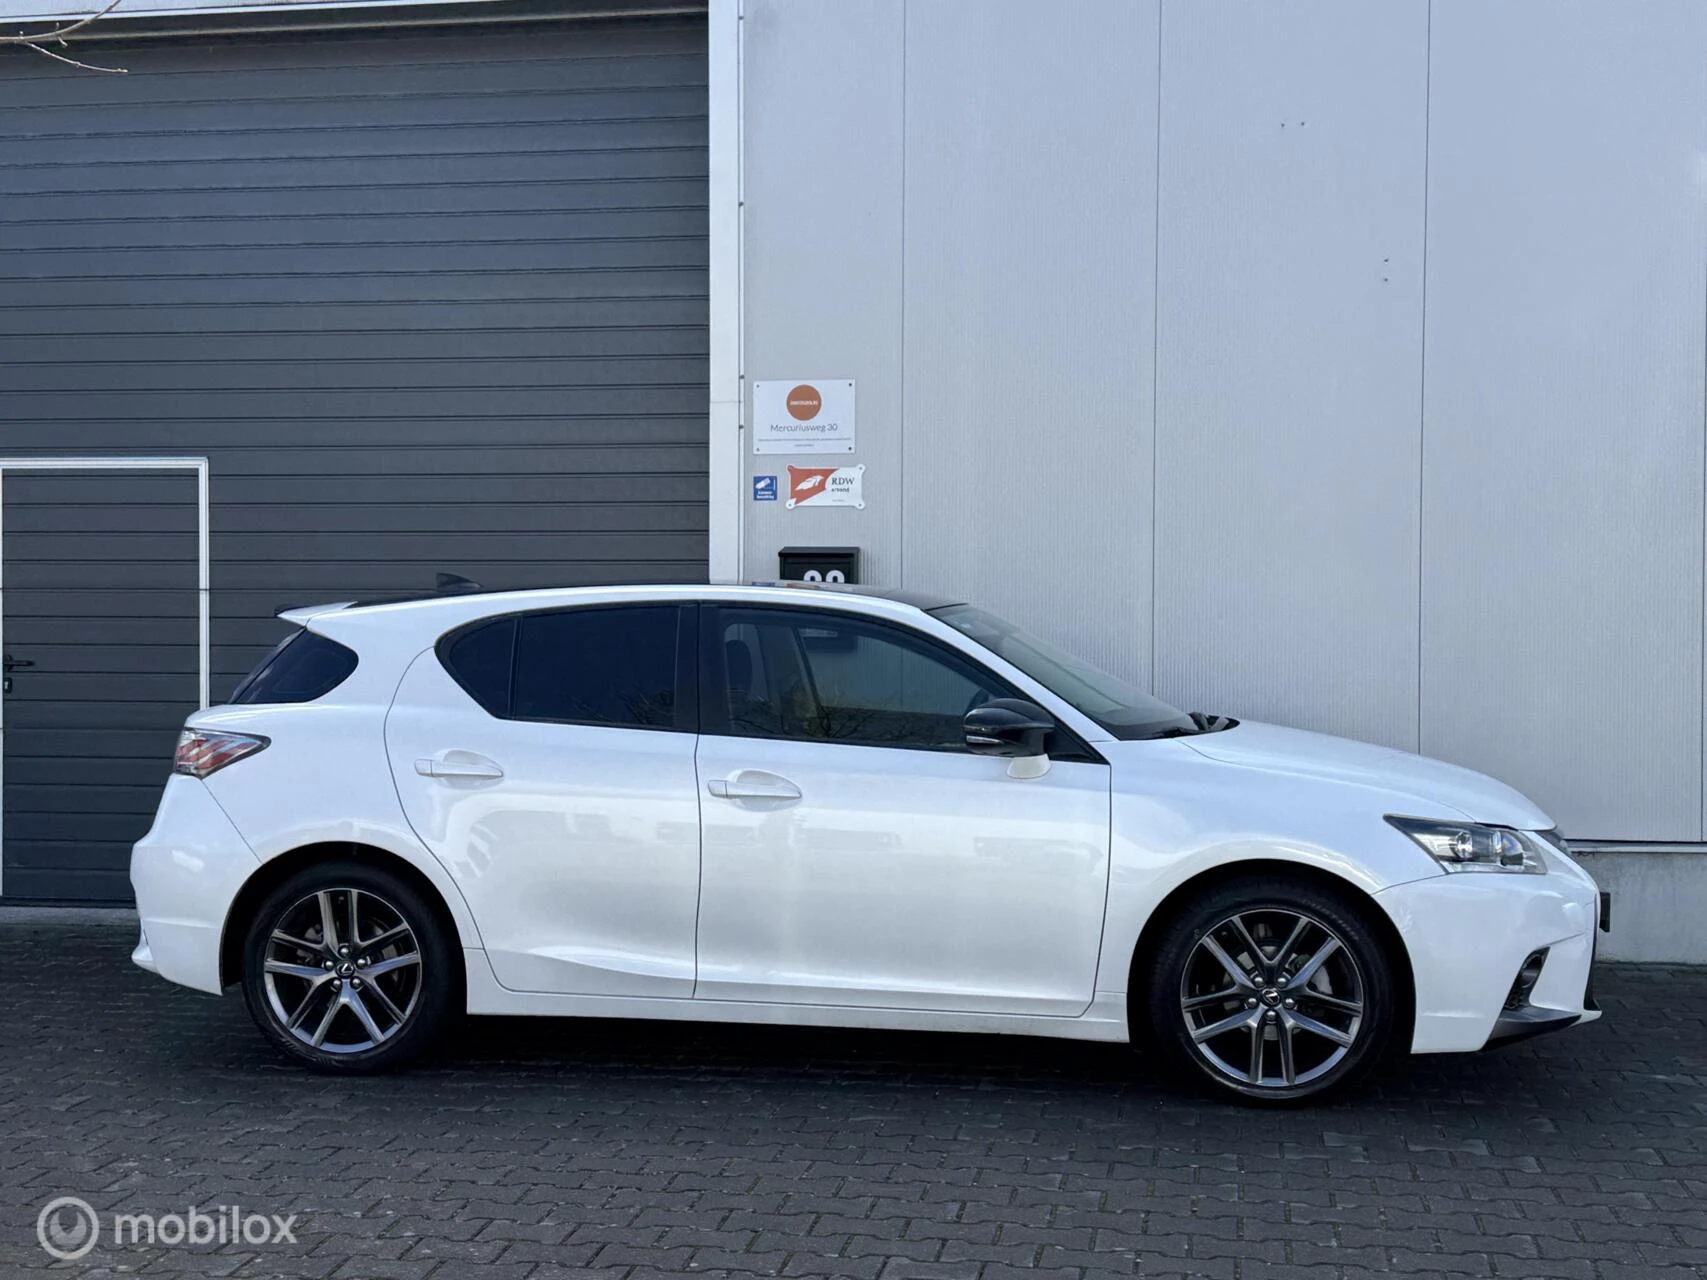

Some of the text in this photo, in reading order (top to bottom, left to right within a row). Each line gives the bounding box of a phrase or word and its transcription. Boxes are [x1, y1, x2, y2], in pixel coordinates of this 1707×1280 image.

[770, 423, 838, 432] Mercuriusweg 30
[831, 477, 854, 485] RDW
